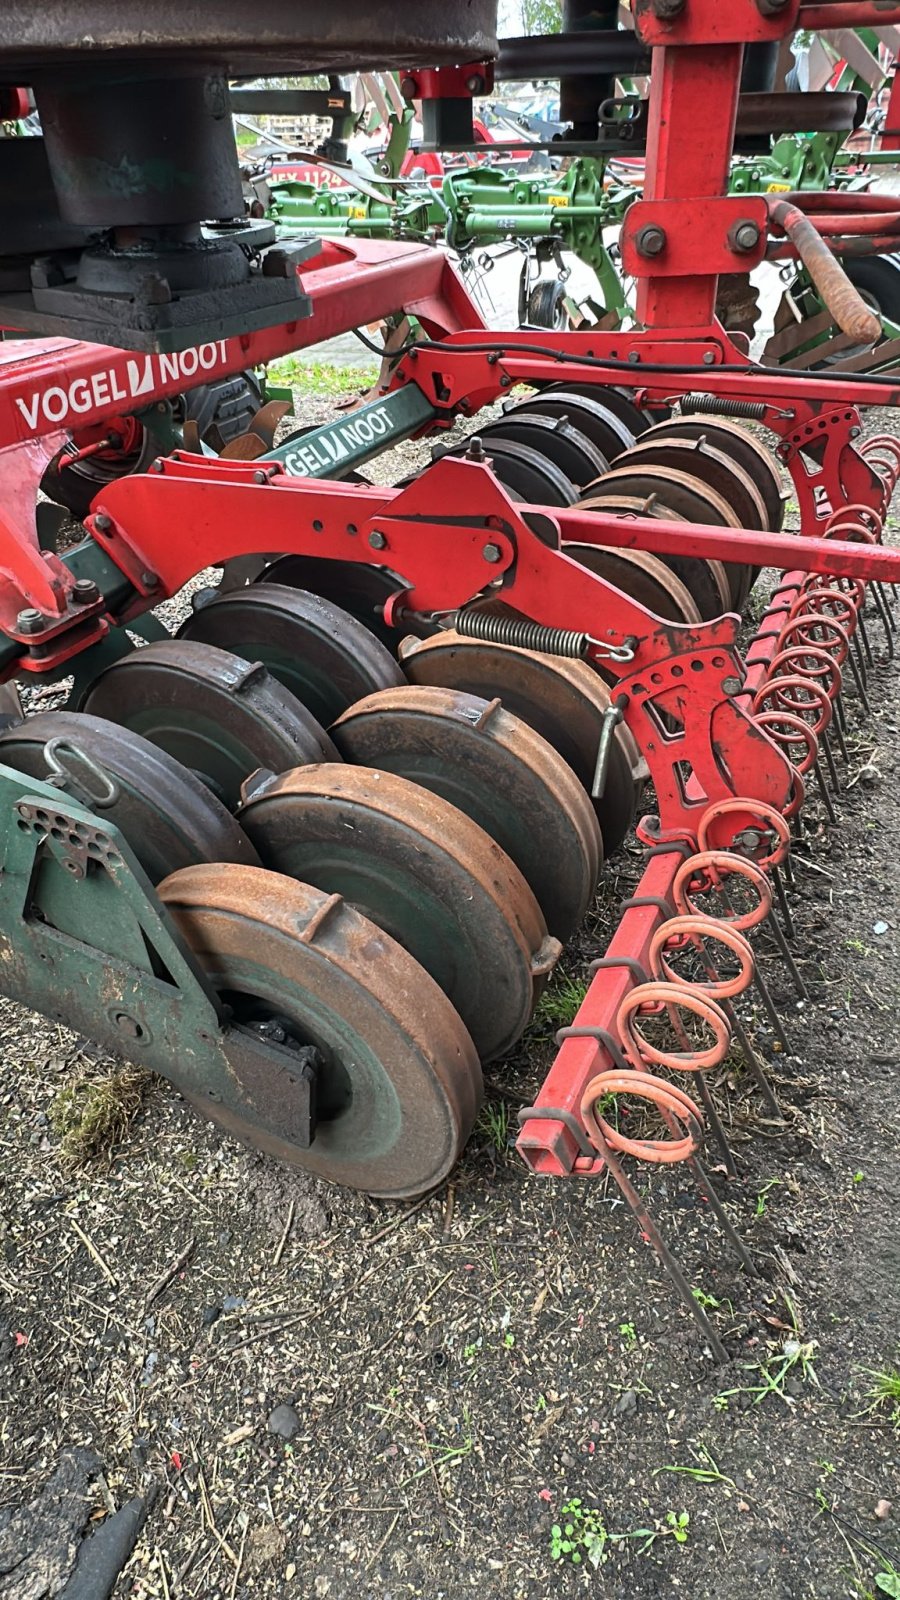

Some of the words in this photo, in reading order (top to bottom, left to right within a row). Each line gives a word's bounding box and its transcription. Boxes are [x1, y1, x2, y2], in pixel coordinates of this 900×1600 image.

[15, 369, 127, 430] VOGEL
[158, 338, 229, 384] NOOT
[285, 444, 331, 477] GEL
[340, 406, 395, 450] NOOT
